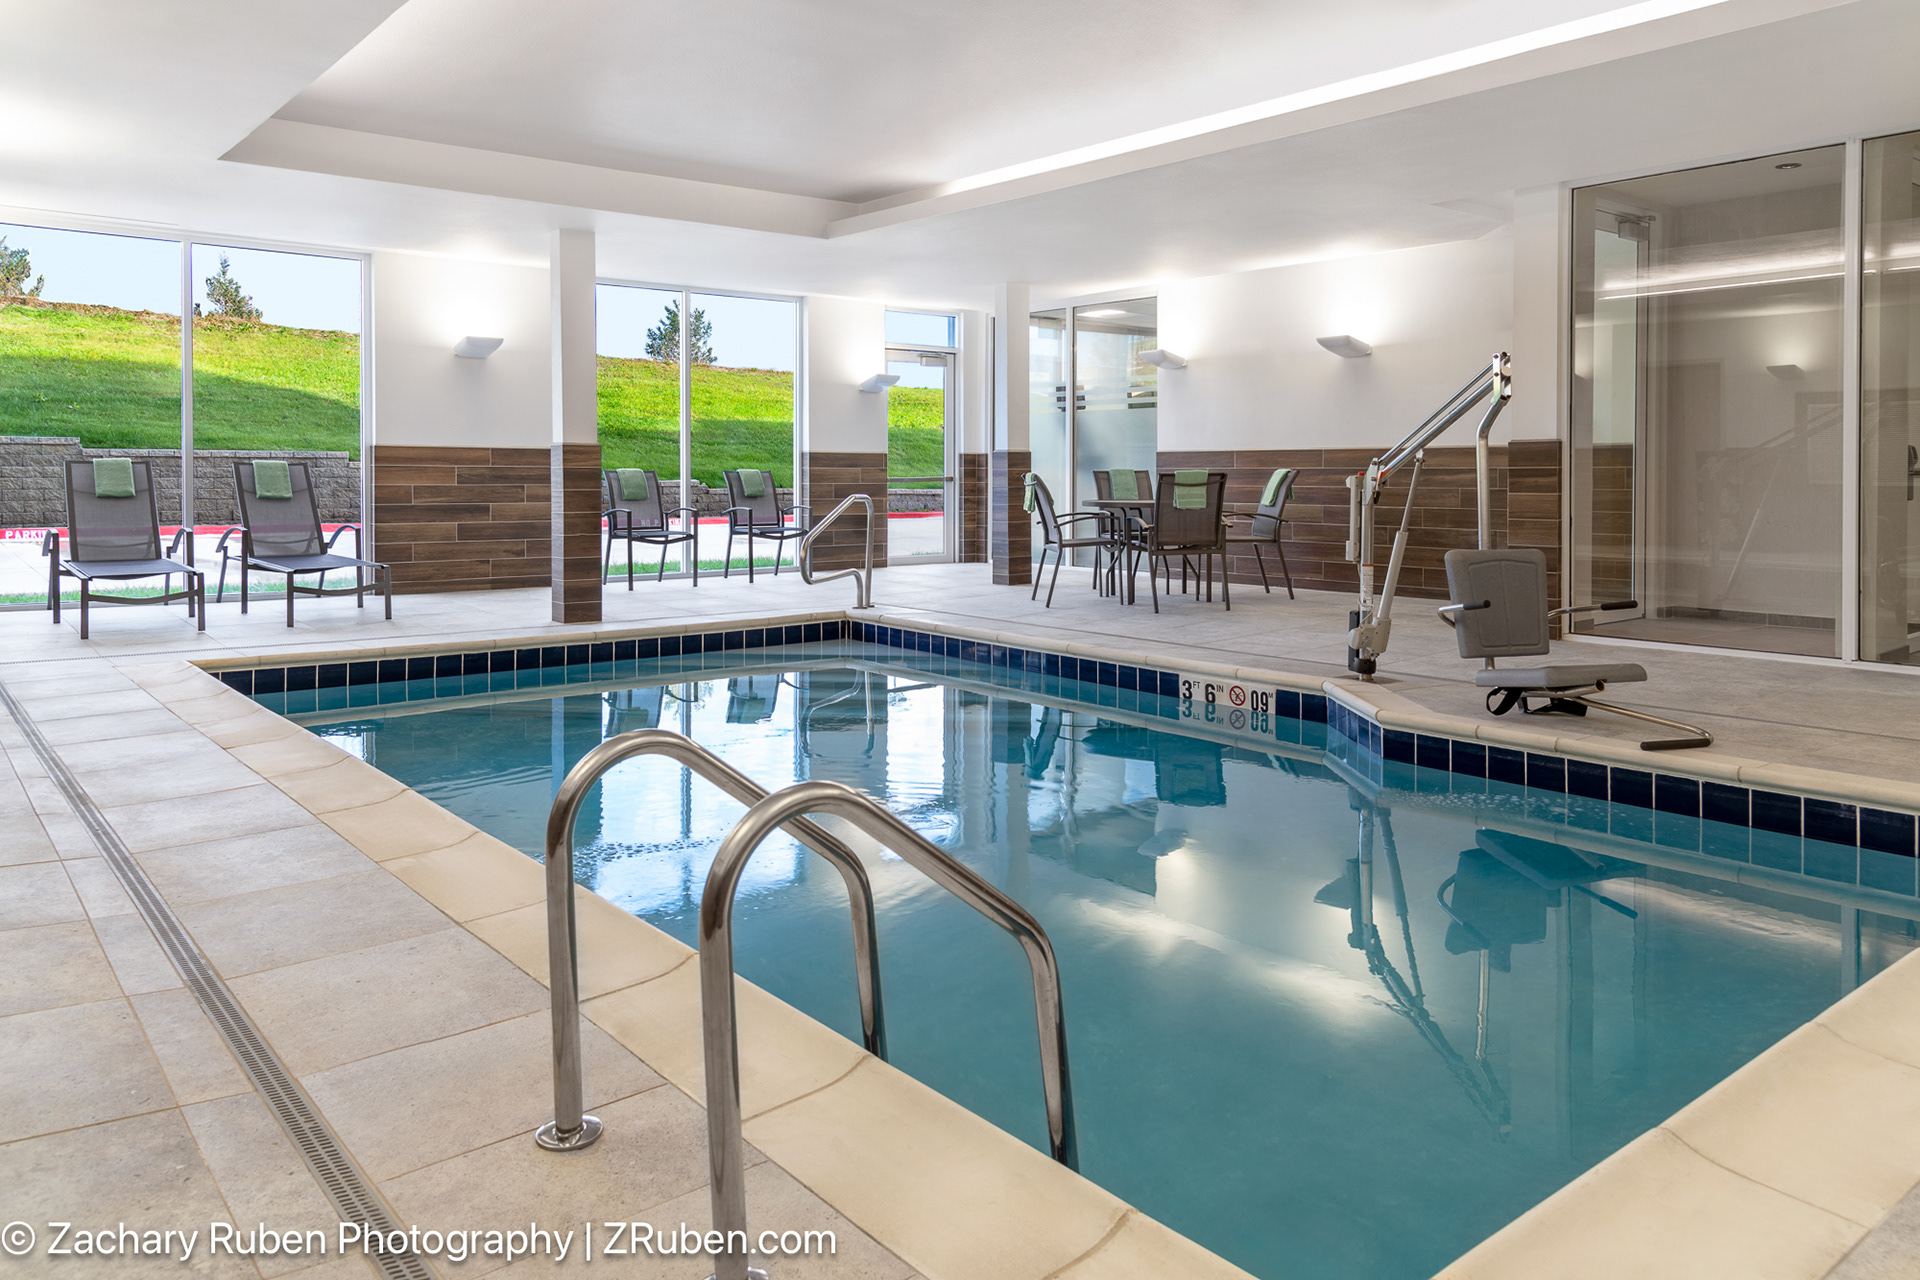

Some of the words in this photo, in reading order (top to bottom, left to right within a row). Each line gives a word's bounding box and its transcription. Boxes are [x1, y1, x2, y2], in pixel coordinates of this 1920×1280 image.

[5, 530, 47, 539] PARKI
[1182, 680, 1193, 699] 3
[1193, 681, 1200, 689] FT
[1205, 684, 1216, 704] 6
[1217, 685, 1224, 693] IN
